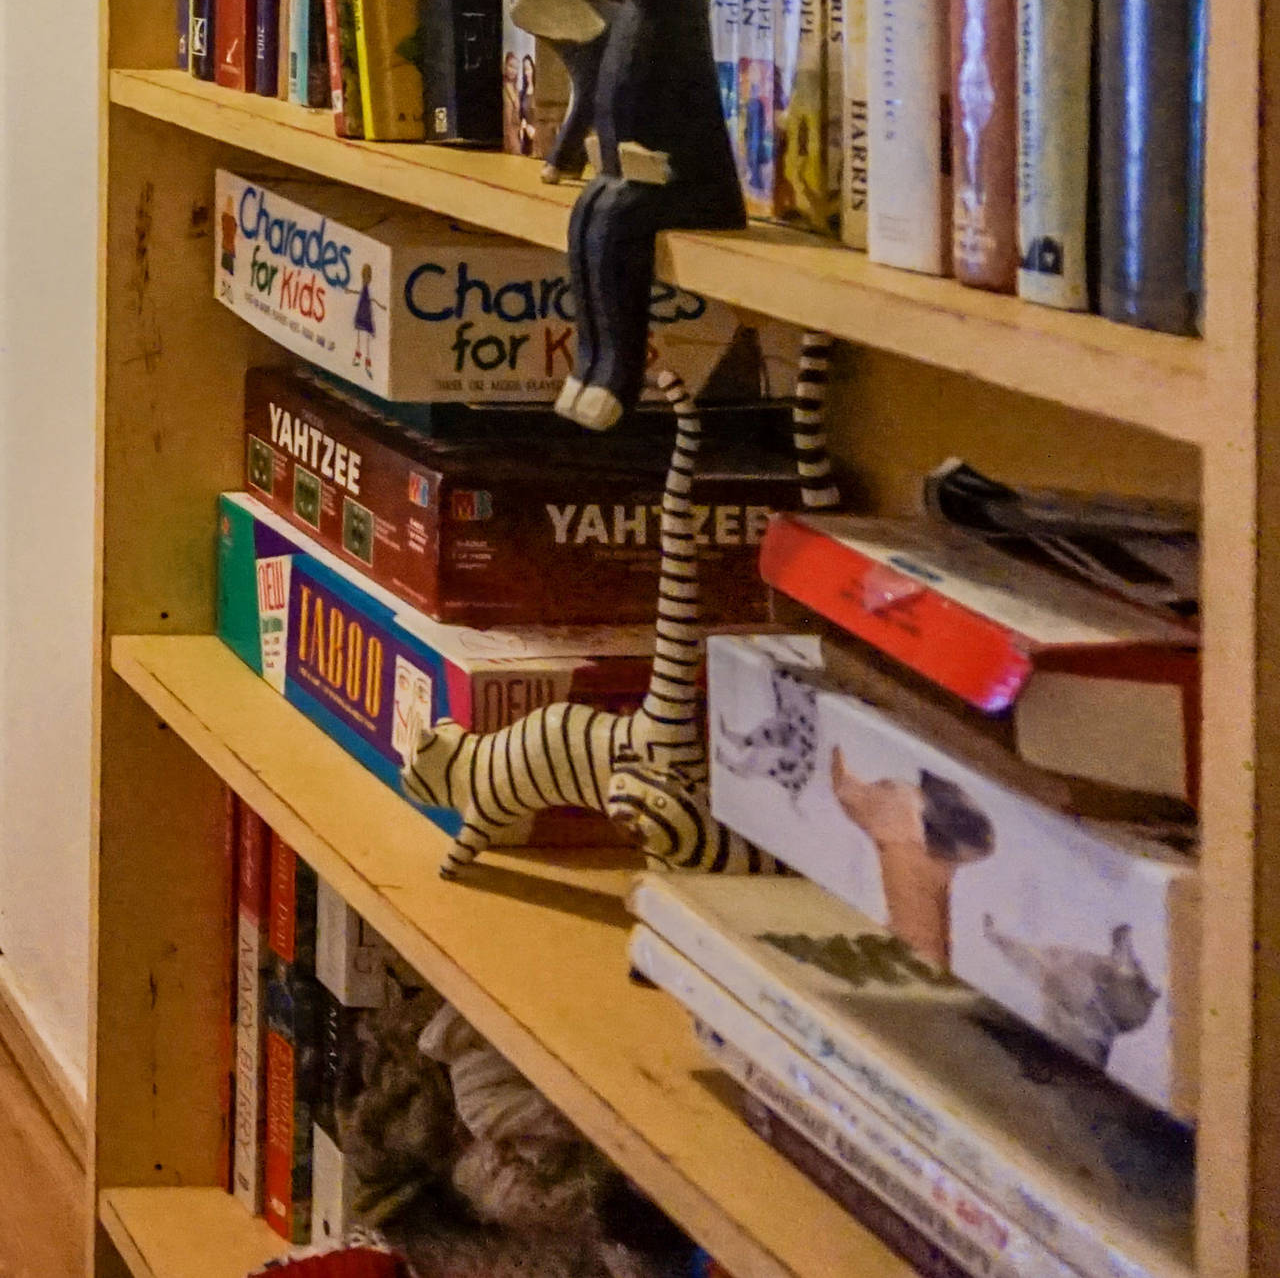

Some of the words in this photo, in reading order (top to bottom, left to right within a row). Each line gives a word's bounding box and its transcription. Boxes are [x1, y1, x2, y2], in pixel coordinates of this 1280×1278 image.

[255, 26, 268, 60] 2004
[851, 99, 867, 212] HARRIS
[240, 187, 352, 287] Charades
[250, 245, 278, 297] for
[280, 265, 326, 324] Kids
[451, 322, 530, 373] for
[269, 401, 363, 496] YAHTZEE
[298, 584, 383, 719] TABOO
[237, 938, 255, 1040] MARY
[236, 1047, 254, 1160] BERRY
